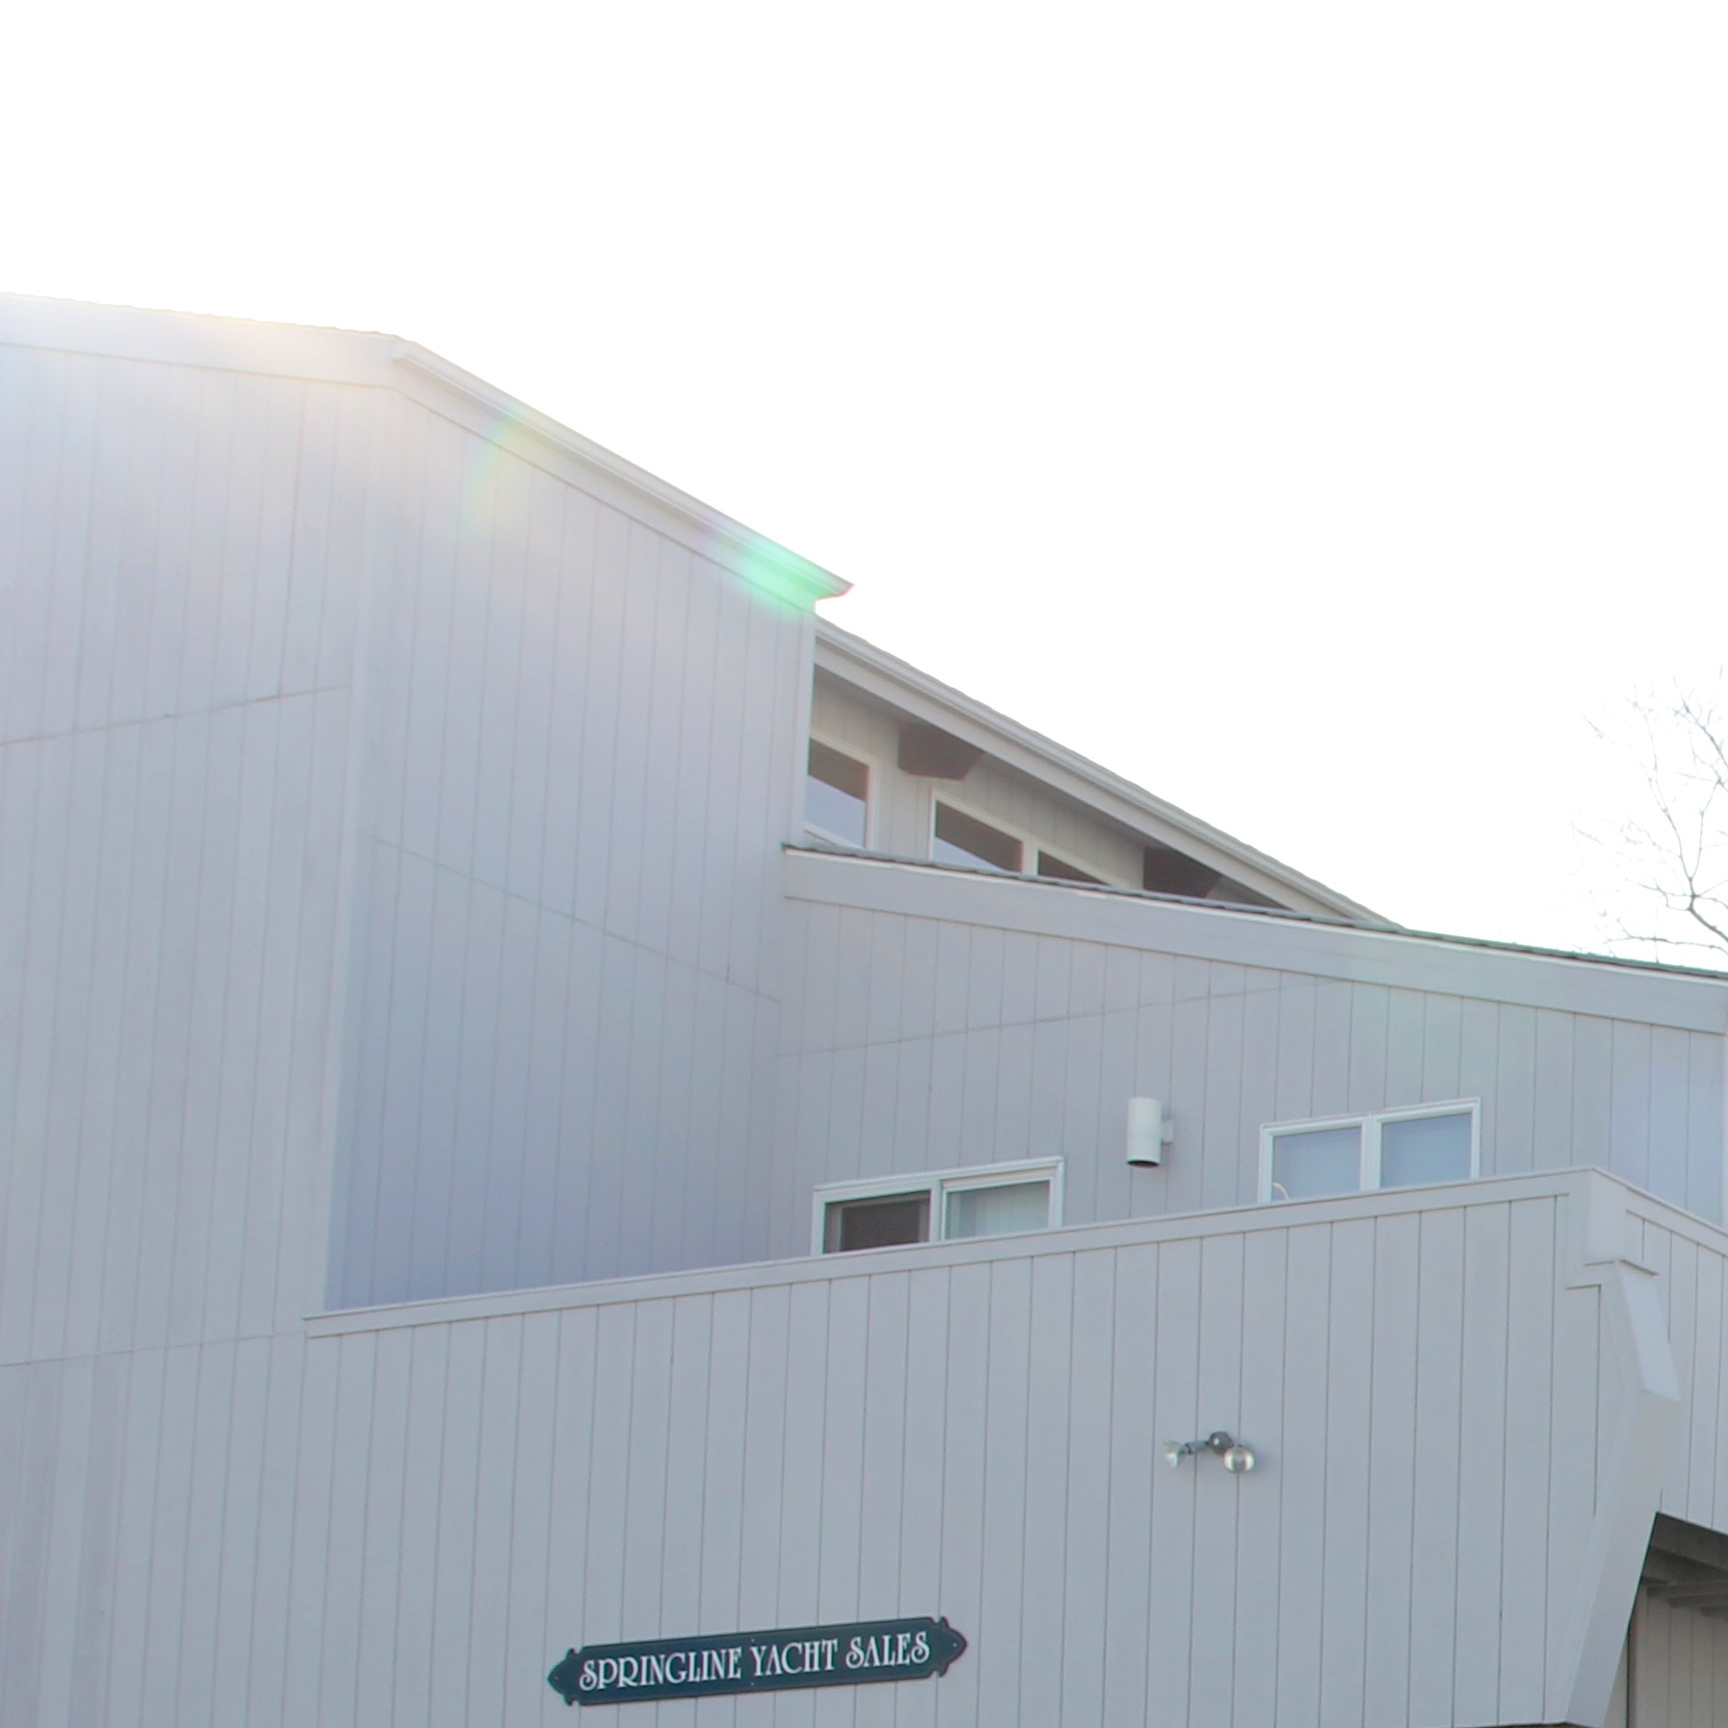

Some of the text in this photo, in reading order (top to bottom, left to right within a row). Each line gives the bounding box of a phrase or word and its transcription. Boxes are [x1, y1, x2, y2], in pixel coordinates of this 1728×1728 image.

[579, 1630, 931, 1692] SPRINGLINE YACHT SALES
